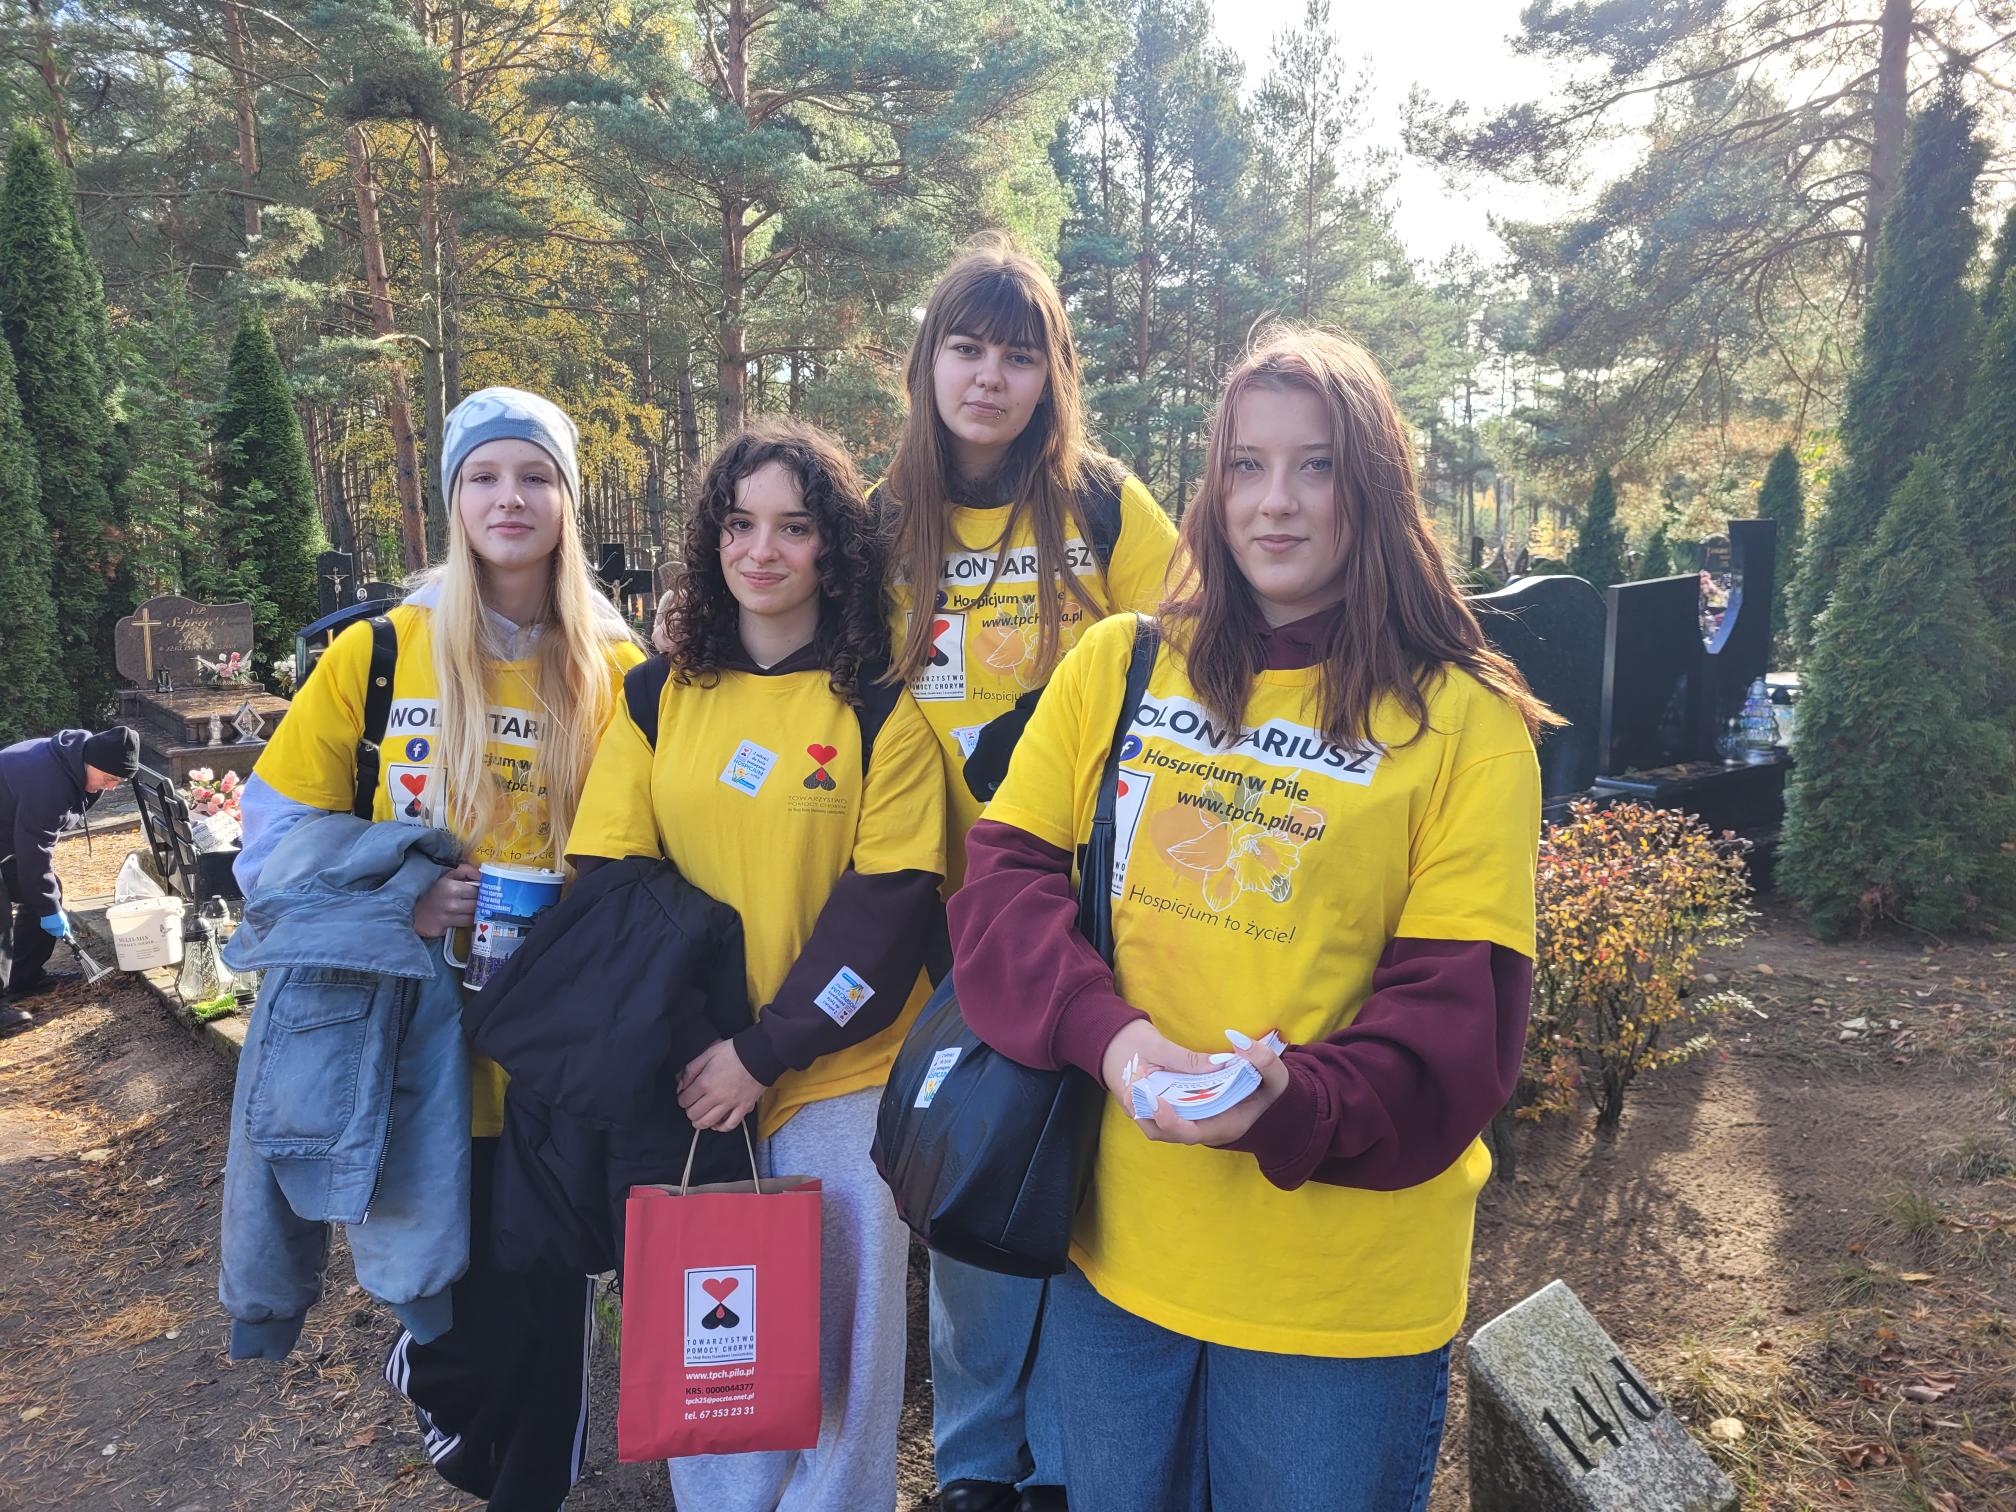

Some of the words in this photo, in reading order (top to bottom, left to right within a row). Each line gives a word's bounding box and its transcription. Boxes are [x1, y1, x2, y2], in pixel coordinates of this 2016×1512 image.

[1020, 594, 1035, 604] w
[982, 610, 1083, 628] www.tpcha.pl
[972, 687, 1023, 703] Hospicju
[1134, 704, 1374, 774] OLONARIUSZ
[1143, 748, 1244, 786] Hospicjum
[1248, 776, 1266, 791] w
[1270, 777, 1309, 802] Pile
[1177, 790, 1326, 842] www.tpch.pila.pl
[1128, 883, 1219, 926] Hospicjum
[1224, 915, 1240, 931] to
[1245, 920, 1297, 945] życie!
[686, 1346, 718, 1354] POMOCY
[722, 1343, 754, 1353] CHORYM
[687, 1335, 754, 1346] TOWARZYSTWO
[685, 1366, 755, 1380] www.tpch.pila.pl
[684, 1411, 698, 1420] tel.
[699, 1410, 711, 1419] 67
[712, 1408, 729, 1418] 353
[730, 1407, 742, 1416] 23
[743, 1405, 754, 1415] 31
